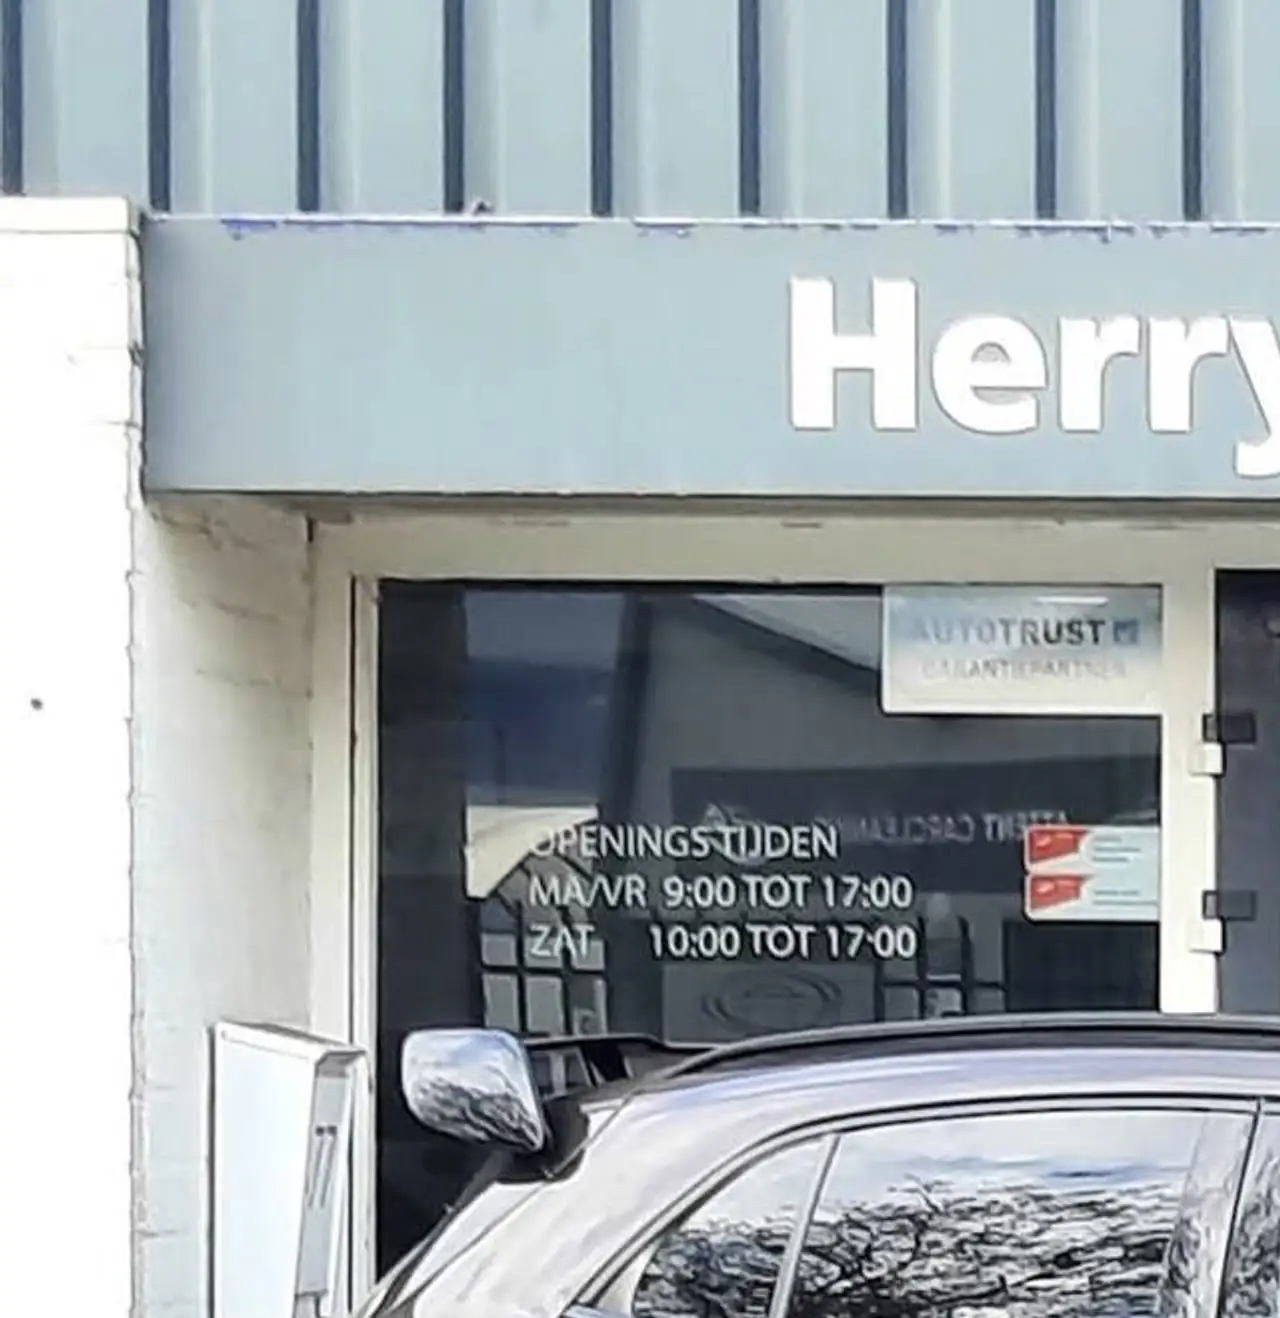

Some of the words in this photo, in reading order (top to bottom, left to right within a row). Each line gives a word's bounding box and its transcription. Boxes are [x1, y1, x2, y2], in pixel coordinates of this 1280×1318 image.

[529, 876, 647, 907] MA/VR
[663, 876, 735, 908] 9:00
[742, 876, 813, 908] TOT
[823, 876, 913, 908] 17:00
[530, 925, 596, 958] ZAT
[650, 926, 740, 958] 10:00
[747, 926, 815, 958] TOT
